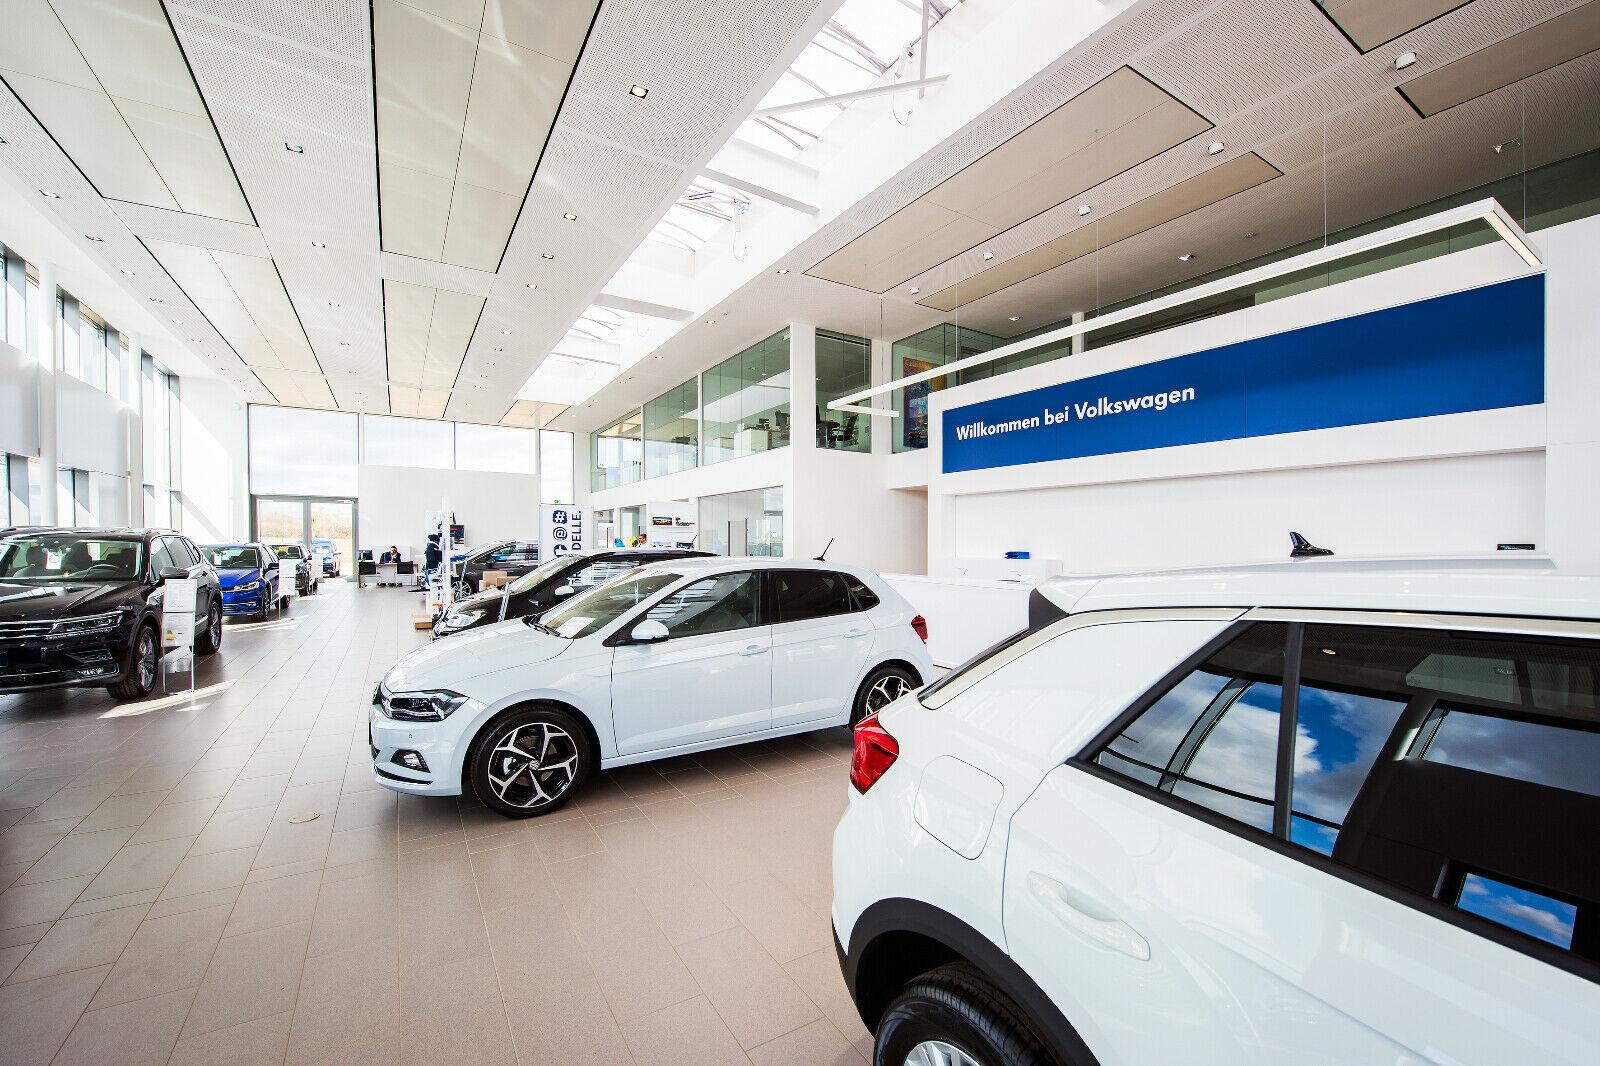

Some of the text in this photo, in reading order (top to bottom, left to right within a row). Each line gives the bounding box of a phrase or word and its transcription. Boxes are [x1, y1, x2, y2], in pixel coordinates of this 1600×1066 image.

[956, 387, 1195, 441] Willkommen bei Volkswagen
